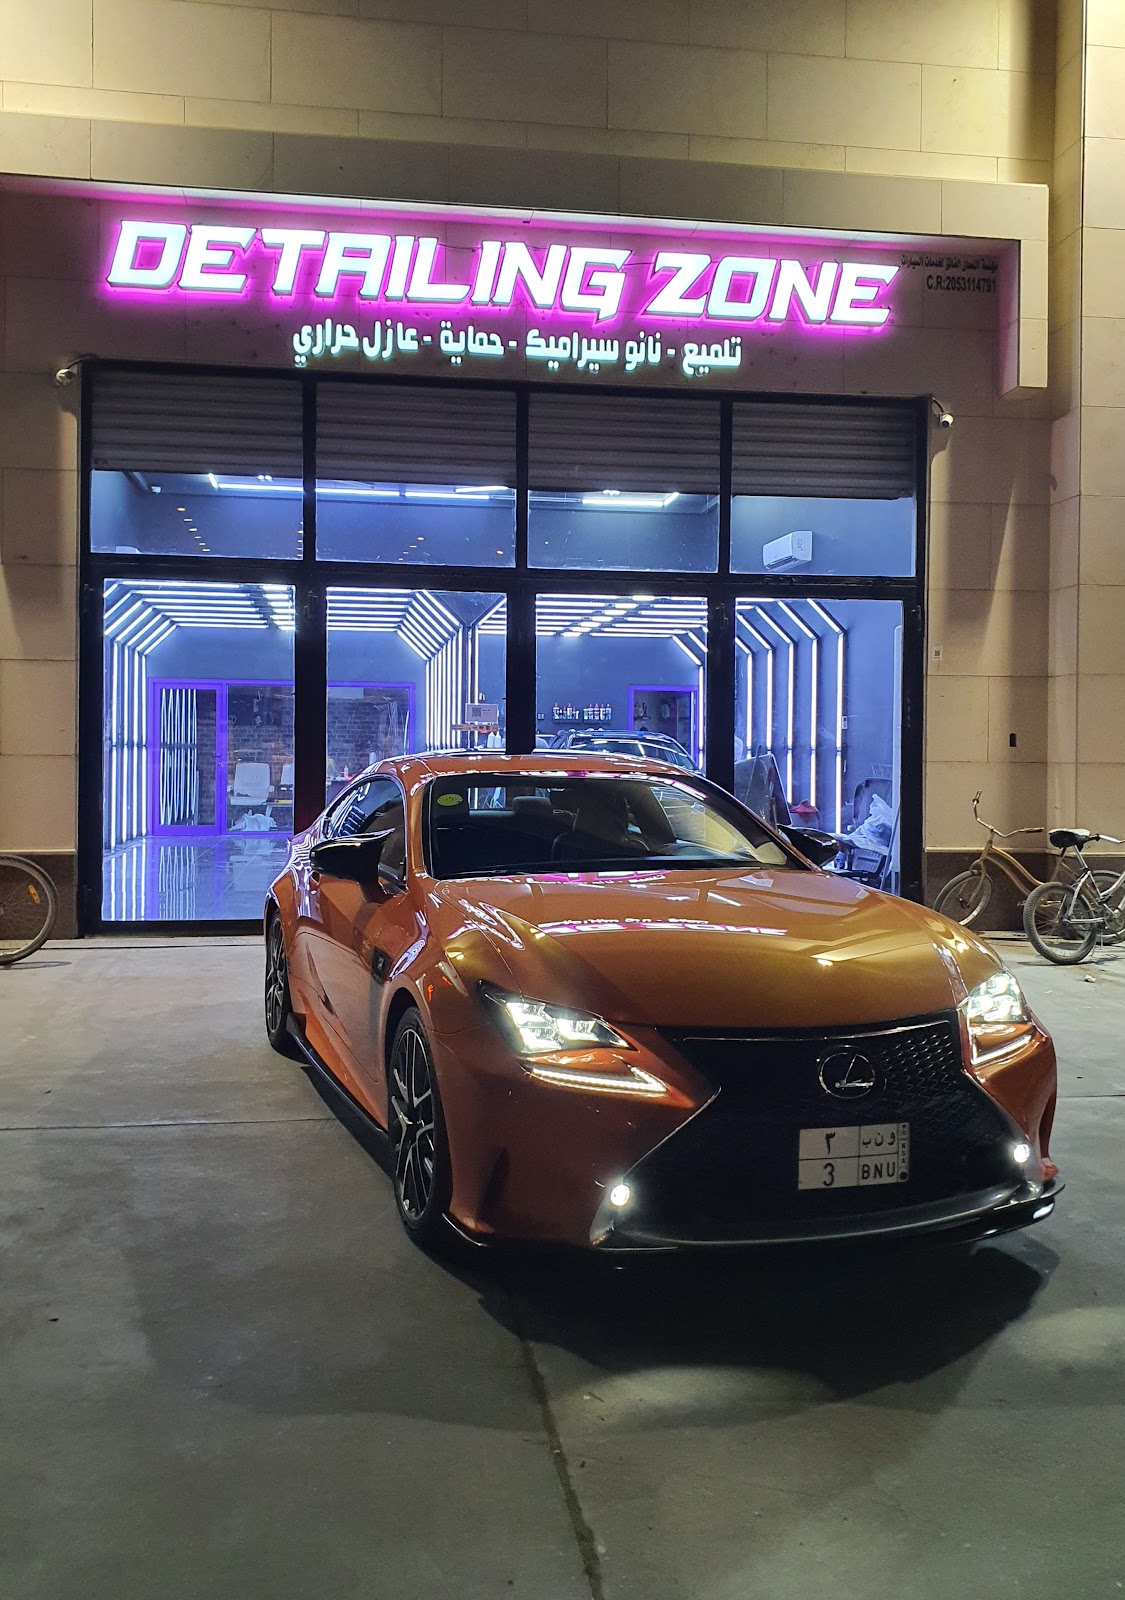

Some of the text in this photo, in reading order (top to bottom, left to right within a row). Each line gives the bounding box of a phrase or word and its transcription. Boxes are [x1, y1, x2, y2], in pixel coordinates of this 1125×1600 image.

[107, 220, 900, 326] DETAILING ZONE
[293, 318, 360, 367] حراري
[362, 318, 419, 360] عازل
[439, 320, 505, 364] حماية
[525, 328, 619, 373] سيراميك
[625, 331, 662, 370] نانو
[682, 336, 742, 375] تلميع
[823, 1162, 835, 1187] 3
[861, 1161, 896, 1180] BNU
